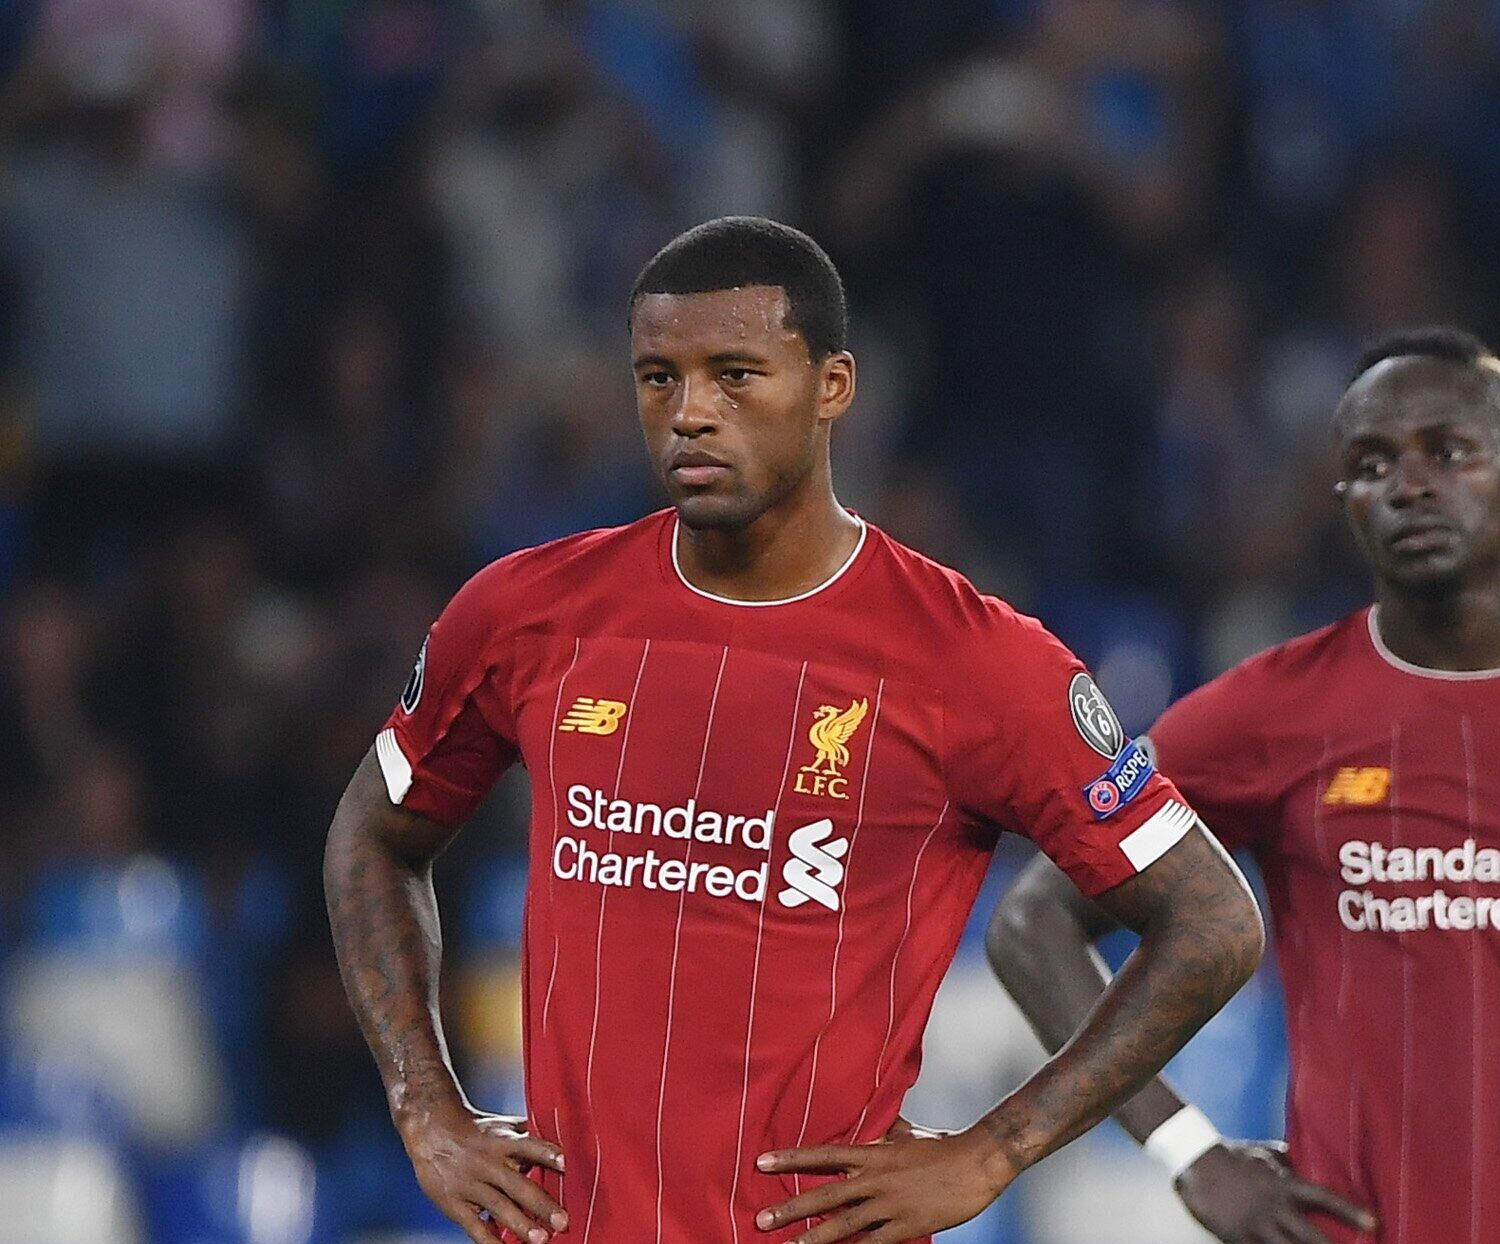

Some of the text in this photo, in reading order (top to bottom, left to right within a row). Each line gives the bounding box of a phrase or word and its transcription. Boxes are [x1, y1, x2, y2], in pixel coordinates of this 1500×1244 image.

[1097, 713, 1111, 736] 6
[566, 784, 775, 850] Standard
[552, 836, 768, 902] Chartered
